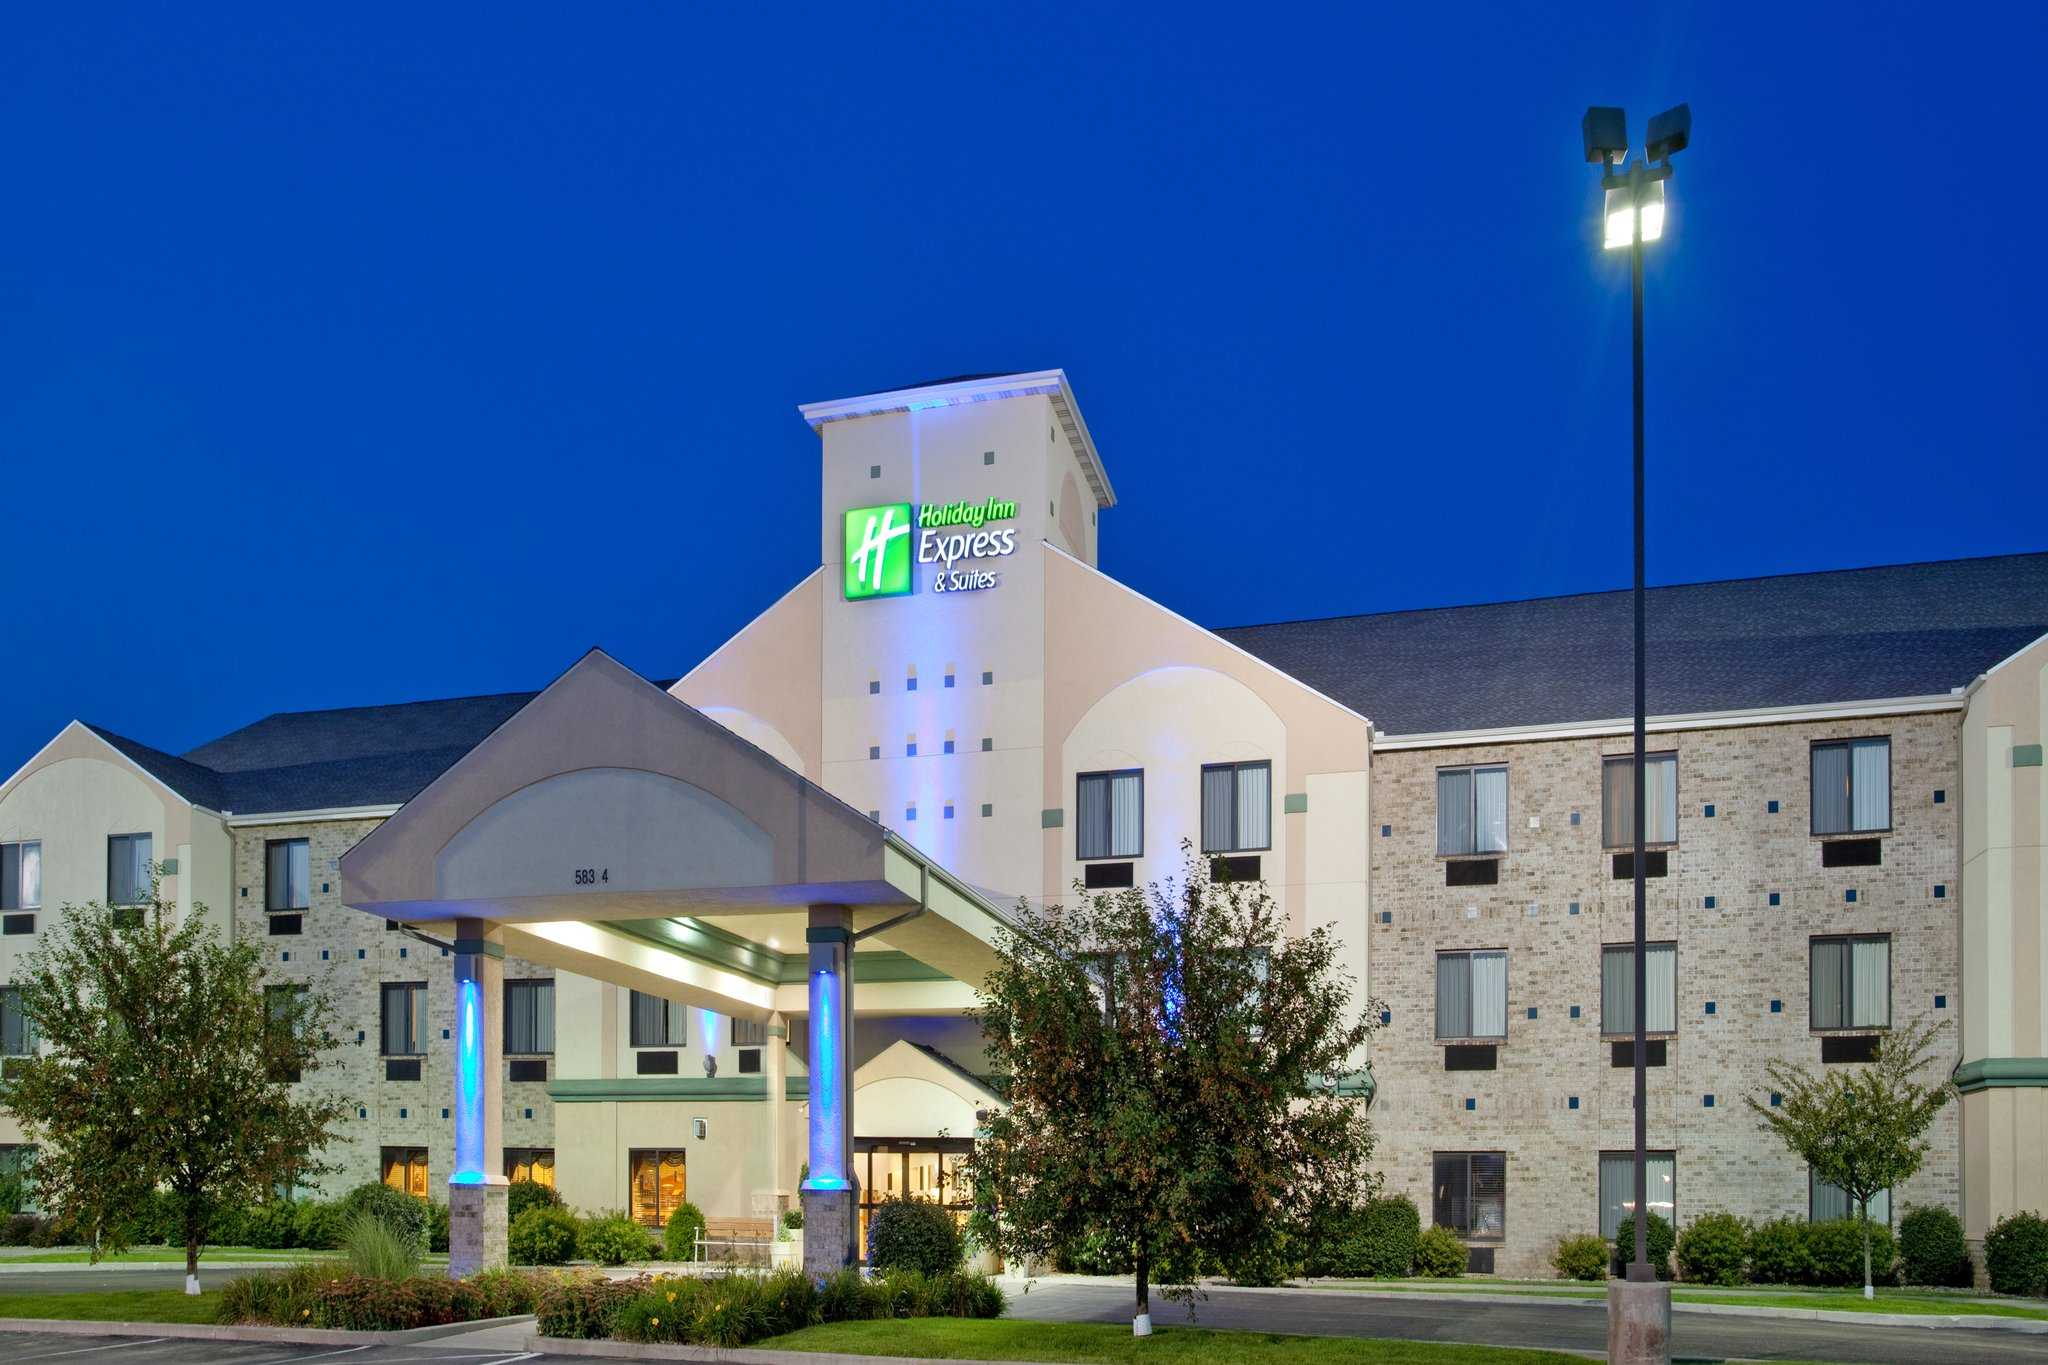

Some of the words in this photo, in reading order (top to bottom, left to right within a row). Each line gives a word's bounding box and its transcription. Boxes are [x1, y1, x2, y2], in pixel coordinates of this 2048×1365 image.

[918, 501, 984, 528] Holiday
[986, 497, 1015, 520] Inn
[851, 509, 910, 590] H
[918, 528, 1016, 569] Express
[934, 572, 945, 593] &
[948, 569, 996, 592] Suites
